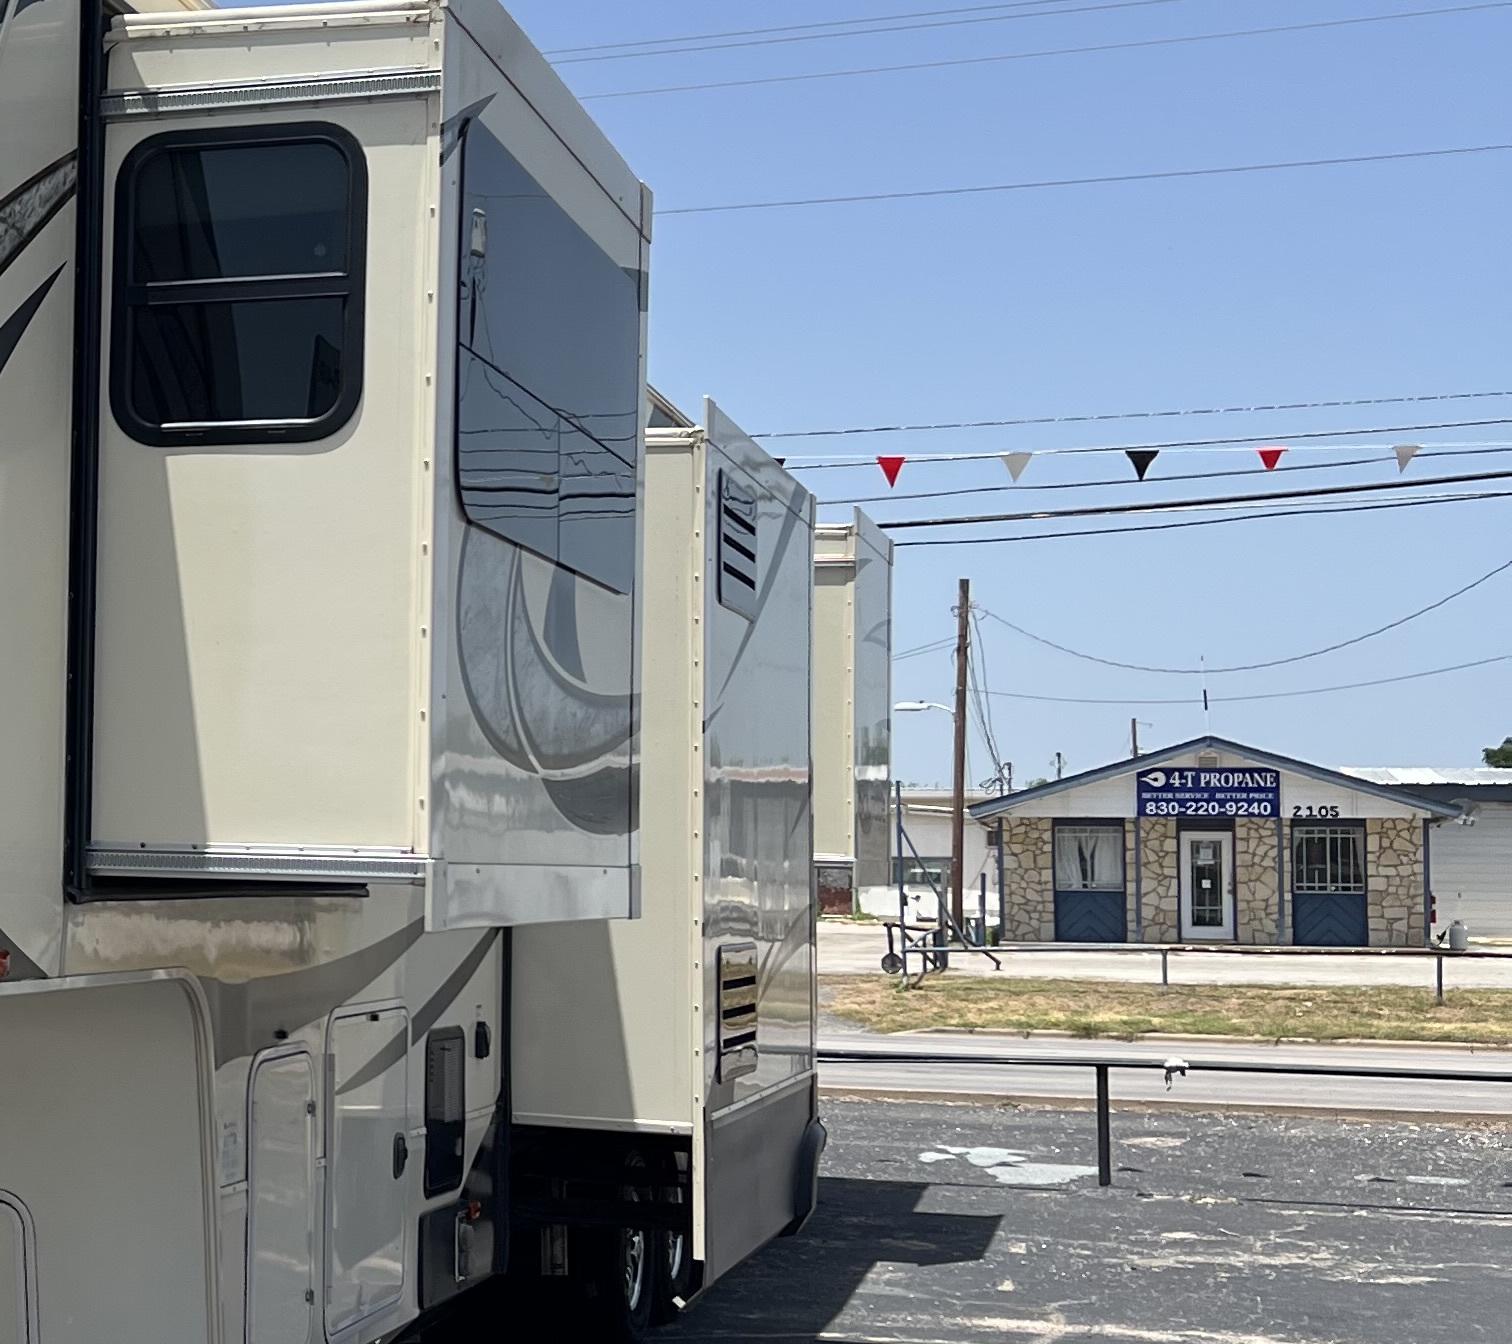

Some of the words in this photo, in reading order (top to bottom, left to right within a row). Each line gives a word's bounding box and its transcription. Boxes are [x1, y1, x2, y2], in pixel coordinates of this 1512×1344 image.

[1169, 771, 1196, 788] 4-T
[1199, 772, 1277, 788] PROPANE
[1145, 801, 1272, 816] 830-220-9240
[1293, 805, 1340, 818] 2105
